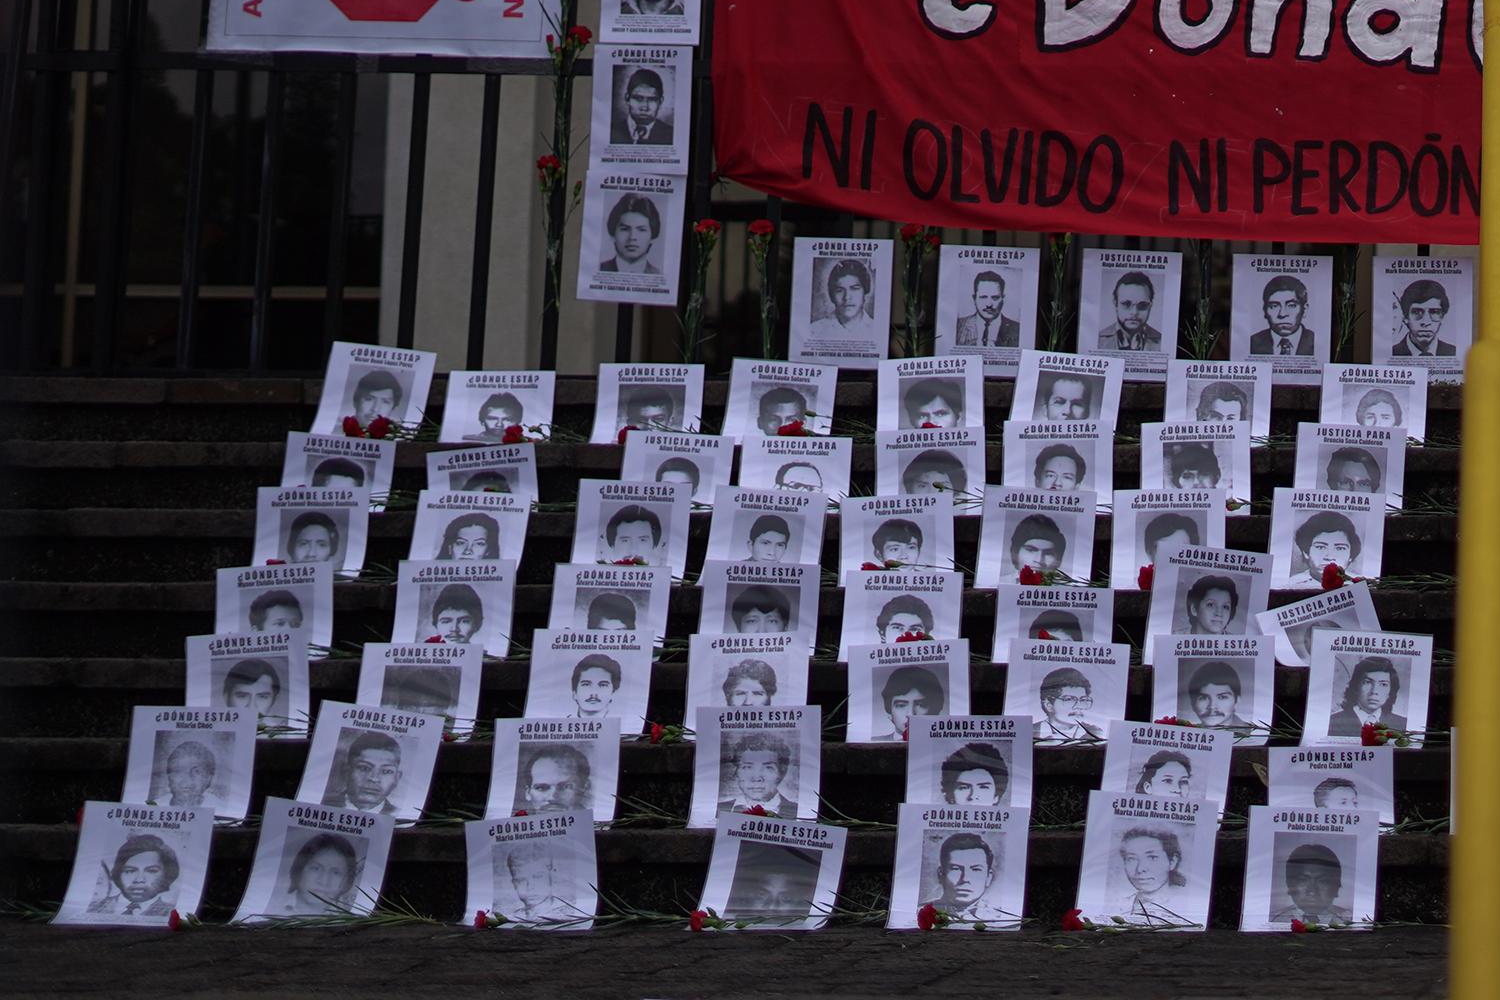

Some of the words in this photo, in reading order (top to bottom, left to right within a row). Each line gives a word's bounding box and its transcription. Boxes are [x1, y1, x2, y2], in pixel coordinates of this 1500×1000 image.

[802, 101, 877, 191] NI
[902, 117, 1125, 214] OLVIDO
[1167, 137, 1228, 216] NI
[1252, 132, 1482, 218] PERDÓN
[349, 348, 387, 361] ¿DÓNDE
[391, 351, 420, 362] ESTÁ?
[1160, 425, 1200, 437] ¿DÓNDE
[1203, 424, 1233, 436] ESTÁ?
[761, 439, 807, 450] JUSTICIA
[811, 441, 837, 451] PARA
[438, 494, 478, 507] ¿DÓNDE
[482, 495, 514, 508] ESTÁ?
[1292, 492, 1339, 505] JUSTICIA
[1344, 495, 1369, 505] PARA
[865, 575, 908, 588] ¿DÓNDE
[912, 575, 944, 588] ESTÁ?
[1111, 798, 1158, 812] ¿DÓNDE
[1163, 801, 1199, 813] ESTÁ?
[106, 808, 154, 821] ¿DÓNDE
[158, 810, 195, 822] ESTÁ?
[287, 807, 334, 824] ¿DÓNDE
[338, 813, 375, 828] ESTÁ?
[922, 810, 968, 822] ¿DÓNDE
[973, 810, 1009, 822] ESTÁ?
[1273, 812, 1319, 825] ¿DÓNDE
[1324, 813, 1360, 825] ESTÁ?
[488, 820, 534, 836] ¿DÓNDE
[539, 815, 574, 832] ESTÁ?
[740, 820, 787, 835] ¿DÓNDE
[791, 826, 827, 839] ESTÁ?
